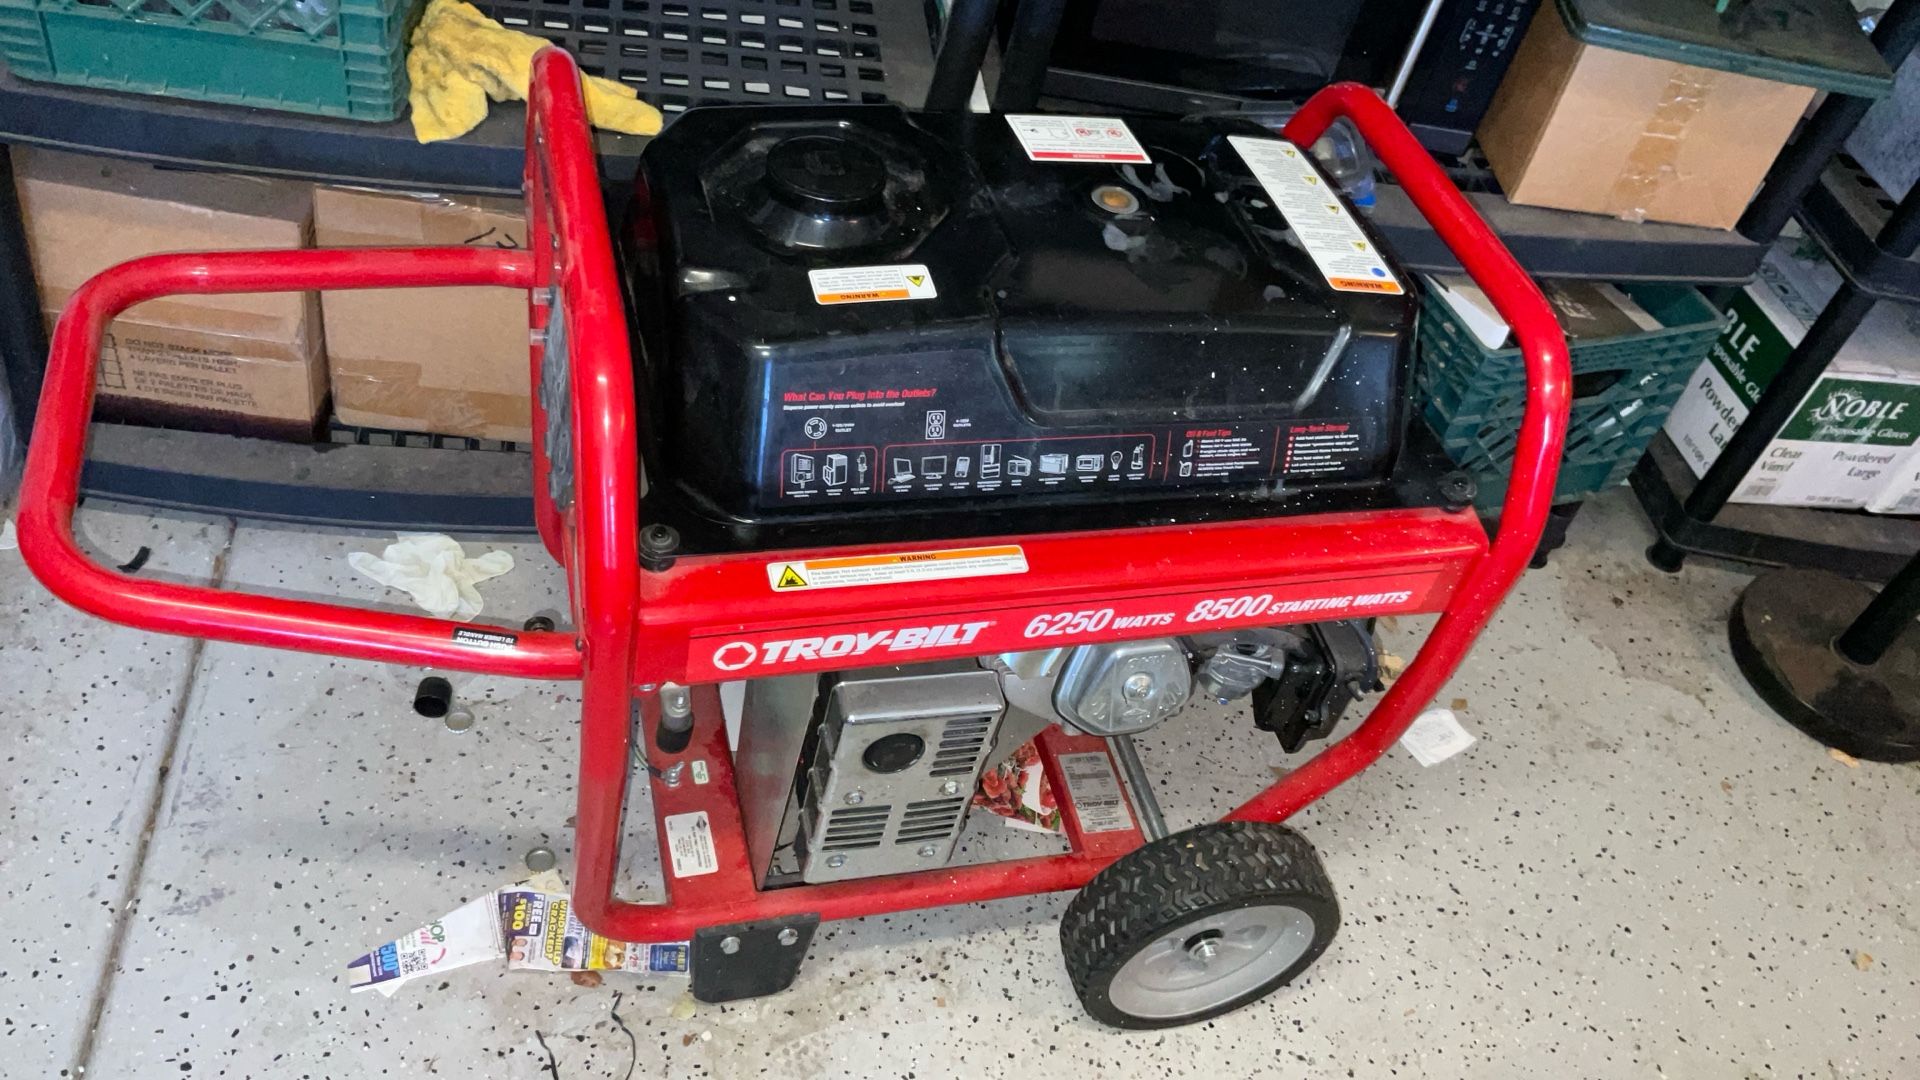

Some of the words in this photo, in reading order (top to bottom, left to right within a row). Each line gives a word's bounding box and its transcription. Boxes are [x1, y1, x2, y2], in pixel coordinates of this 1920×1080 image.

[1721, 308, 1760, 361] BLE
[1713, 342, 1747, 385] sposable
[784, 392, 806, 401] What
[808, 392, 825, 401] Can
[828, 391, 844, 400] You
[846, 390, 866, 401] Plug
[867, 390, 884, 399] Into
[886, 389, 900, 398] the
[902, 388, 938, 398] Outlets?
[1699, 377, 1741, 433] Powder
[1816, 393, 1909, 421] NOBLE
[1760, 461, 1794, 473] Vinyl
[1770, 447, 1803, 458] Clear
[1833, 450, 1896, 465] Powdered
[1847, 466, 1881, 480] Large
[899, 554, 937, 562] WARNING
[1185, 594, 1275, 624] 8500
[1266, 596, 1350, 616] STARTING
[1351, 590, 1413, 608] WATTS
[458, 630, 484, 639] HANDLE
[483, 634, 505, 642] LOWER
[1023, 608, 1114, 639] 6250
[1112, 612, 1175, 631] WATTS
[456, 637, 490, 648] BUTTON
[762, 620, 990, 665] TROY-BILT
[512, 898, 528, 931] $100
[532, 893, 545, 923] FREE
[544, 902, 559, 960] CRACKED?
[552, 899, 568, 965] WINDSHIELD
